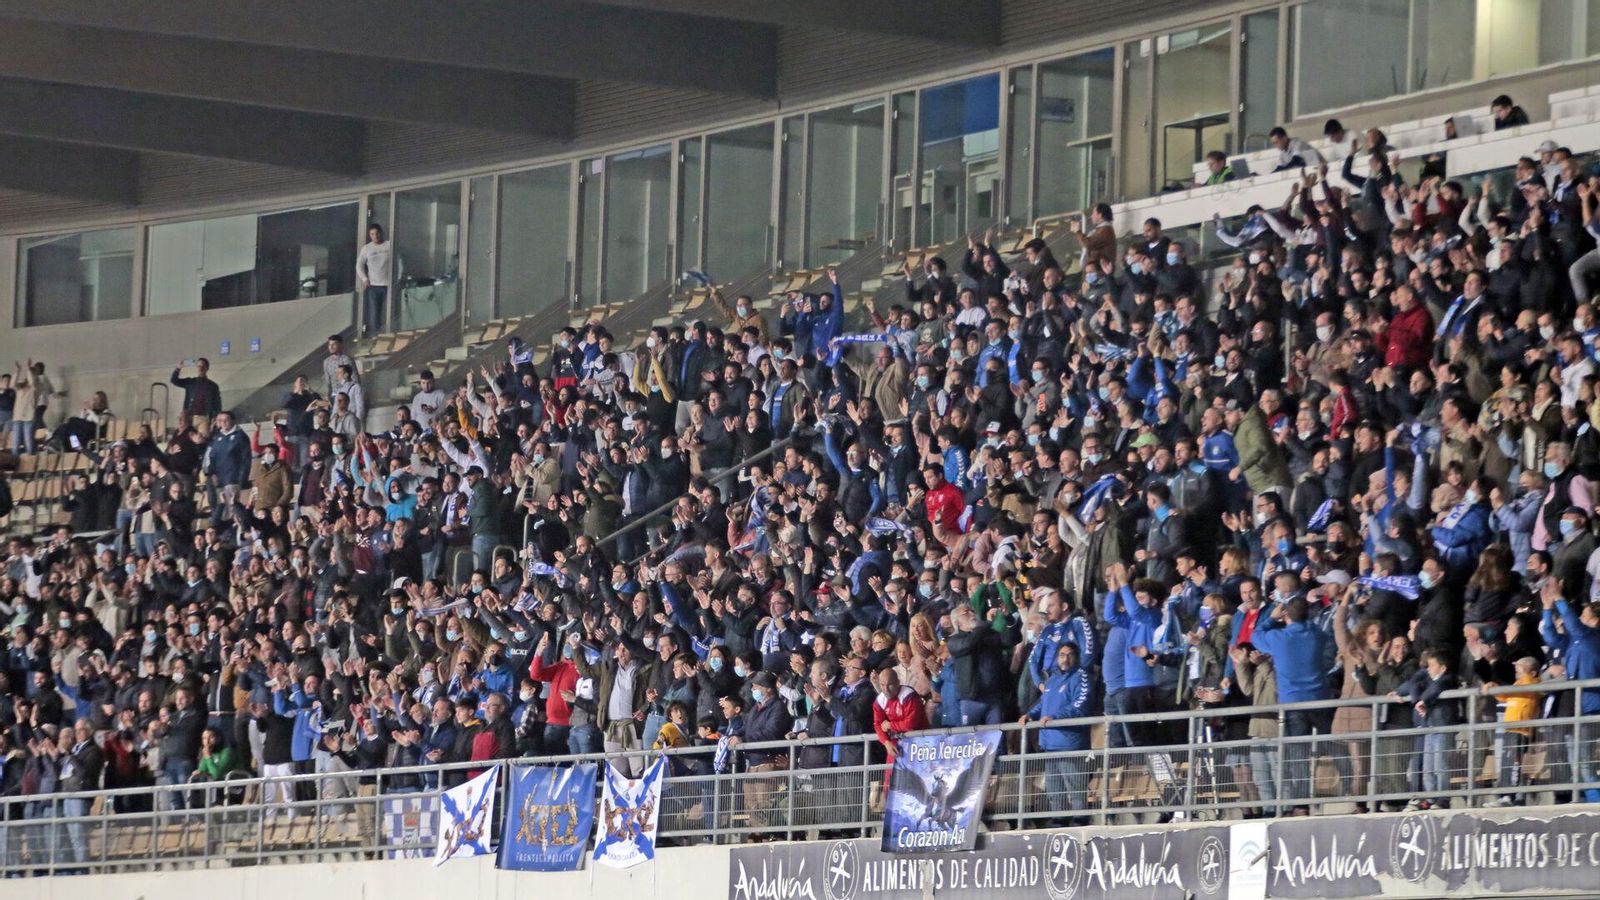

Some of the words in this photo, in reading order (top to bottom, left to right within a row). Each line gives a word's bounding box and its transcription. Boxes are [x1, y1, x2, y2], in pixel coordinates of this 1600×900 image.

[1086, 840, 1186, 892] Andalucía
[1272, 832, 1378, 888] Andalucía
[1557, 833, 1582, 867] DE
[734, 857, 817, 900] Andalucía
[951, 859, 968, 889] DE
[974, 855, 1039, 888] CALIDAD
